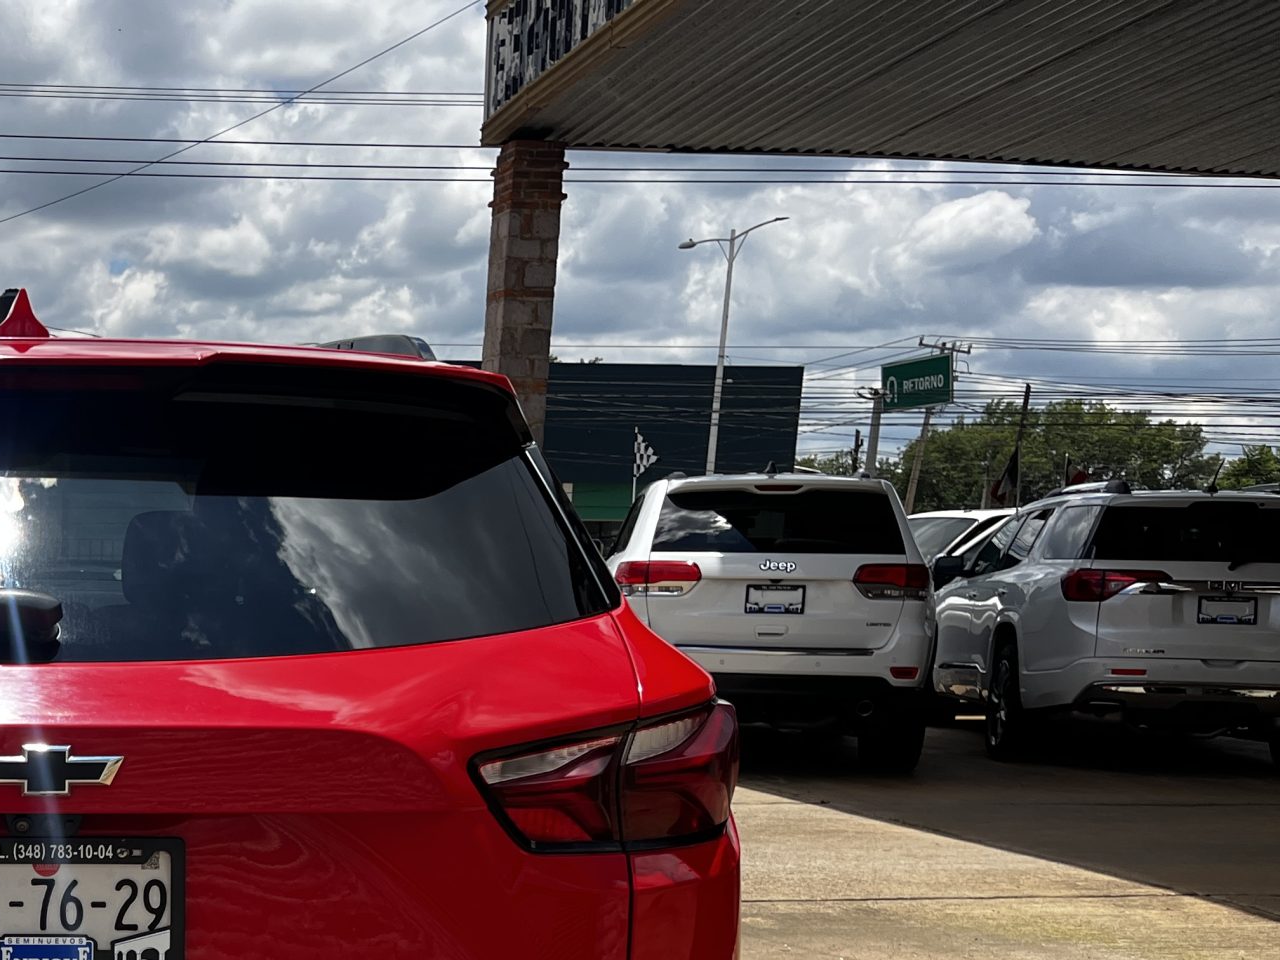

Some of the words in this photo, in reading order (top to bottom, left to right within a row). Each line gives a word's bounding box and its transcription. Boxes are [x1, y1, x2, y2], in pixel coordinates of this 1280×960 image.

[903, 374, 944, 394] RETORNO
[759, 559, 797, 573] Jeep
[13, 844, 46, 860] (348)
[50, 844, 114, 859] 783-10-04
[7, 937, 86, 945] SEMINUEVOS
